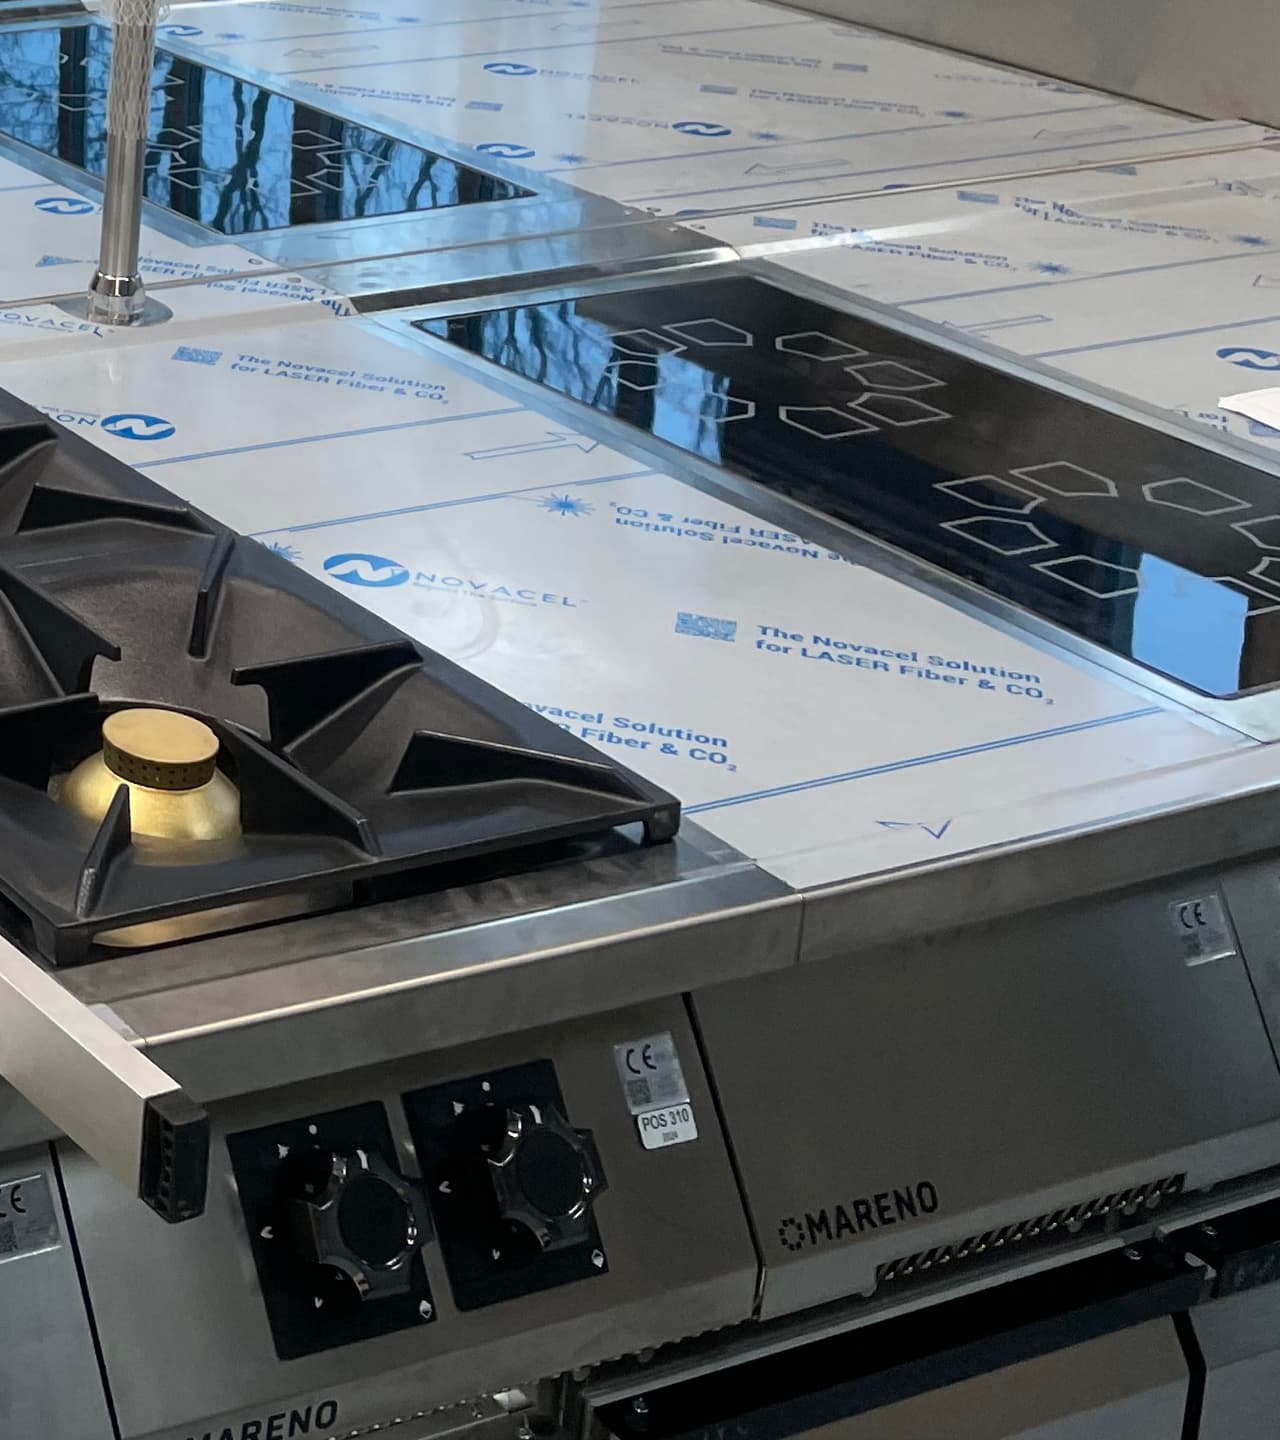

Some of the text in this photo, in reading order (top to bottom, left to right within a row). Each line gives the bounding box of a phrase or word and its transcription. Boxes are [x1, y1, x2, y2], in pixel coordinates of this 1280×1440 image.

[277, 359, 356, 377] Novacel
[616, 518, 819, 559] Novacel Solution
[683, 516, 742, 535] Fiber
[416, 570, 577, 608] NOVACEL
[755, 640, 792, 654] for
[800, 647, 890, 672] LASER
[899, 664, 969, 686] Fiber
[756, 624, 1041, 684] The Novacel Solution
[580, 727, 653, 750] Fiber
[612, 716, 729, 749] Solution
[1181, 902, 1207, 929] CE
[626, 1043, 657, 1075] CE
[641, 1107, 690, 1132] POS 310
[804, 1181, 938, 1245] MARENO
